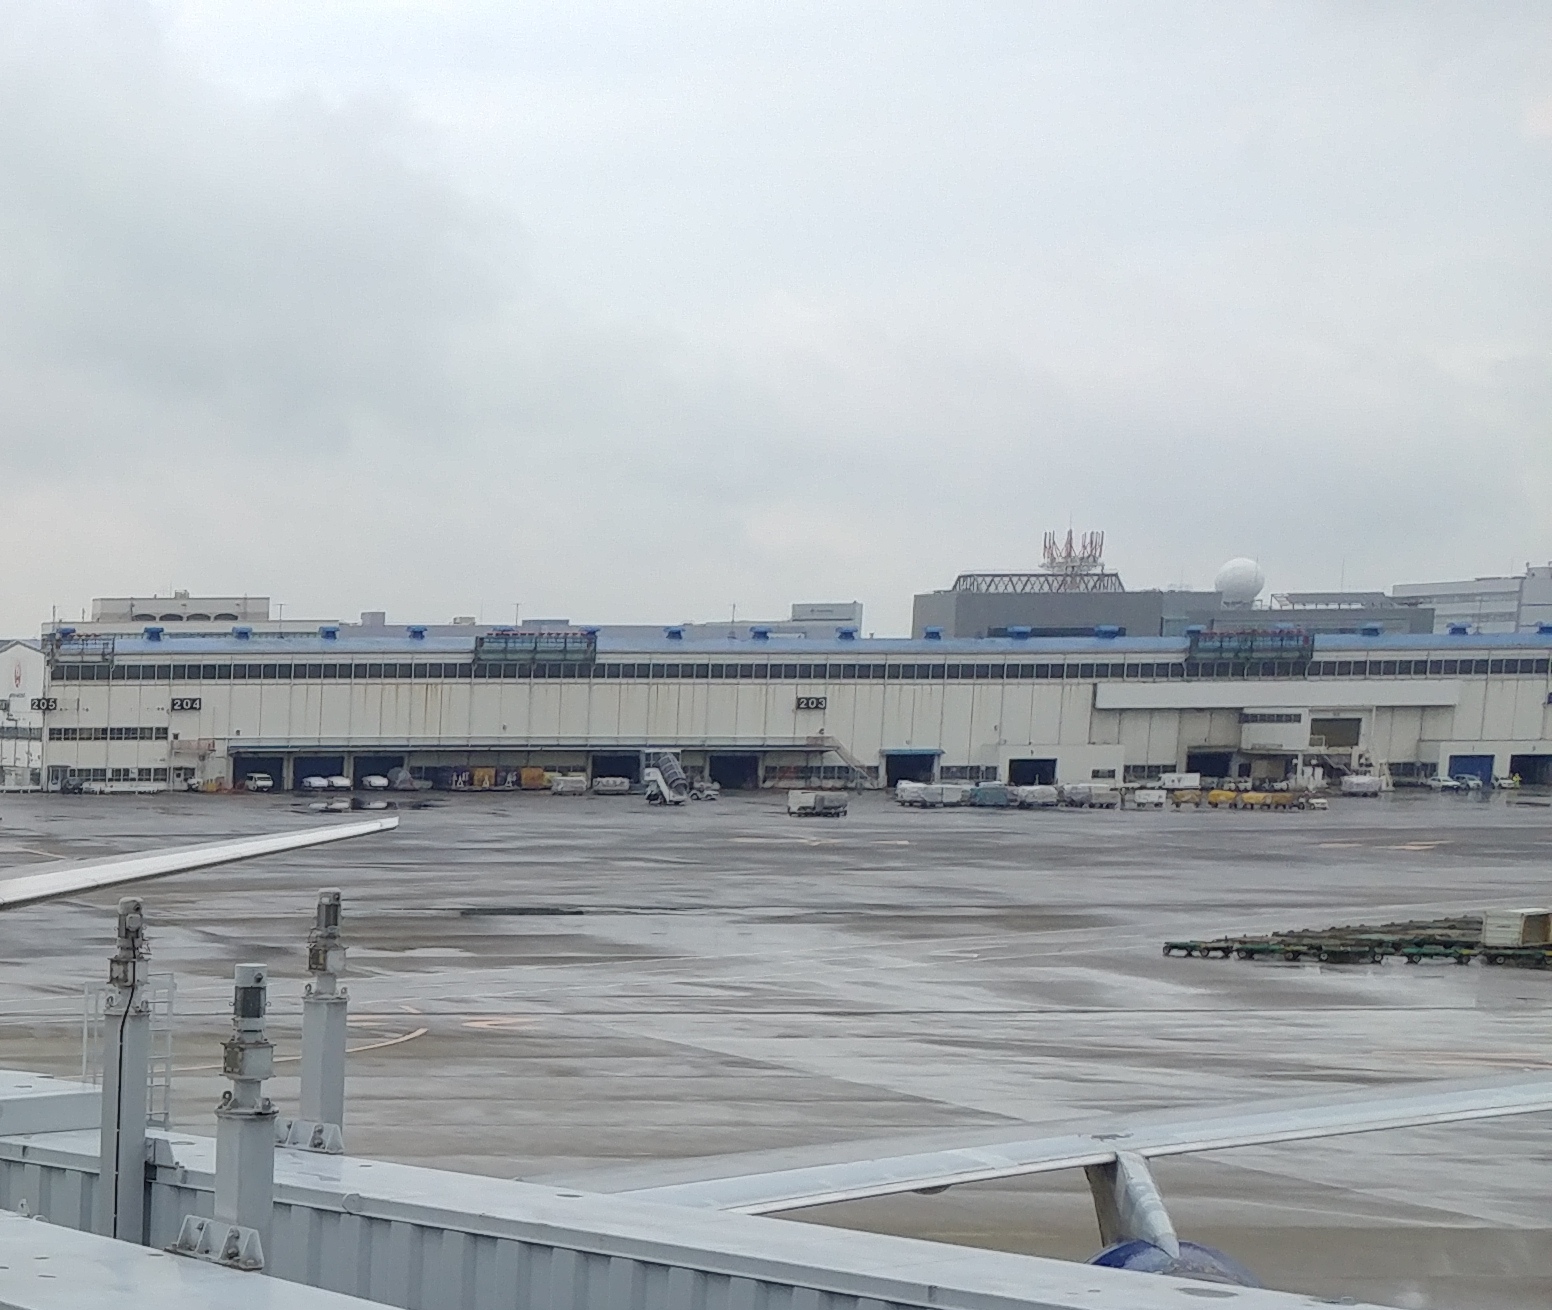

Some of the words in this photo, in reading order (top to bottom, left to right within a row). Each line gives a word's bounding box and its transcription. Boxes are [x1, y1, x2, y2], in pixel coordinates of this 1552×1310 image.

[31, 701, 56, 710] 205
[173, 700, 200, 710] 204
[799, 698, 826, 709] 203
